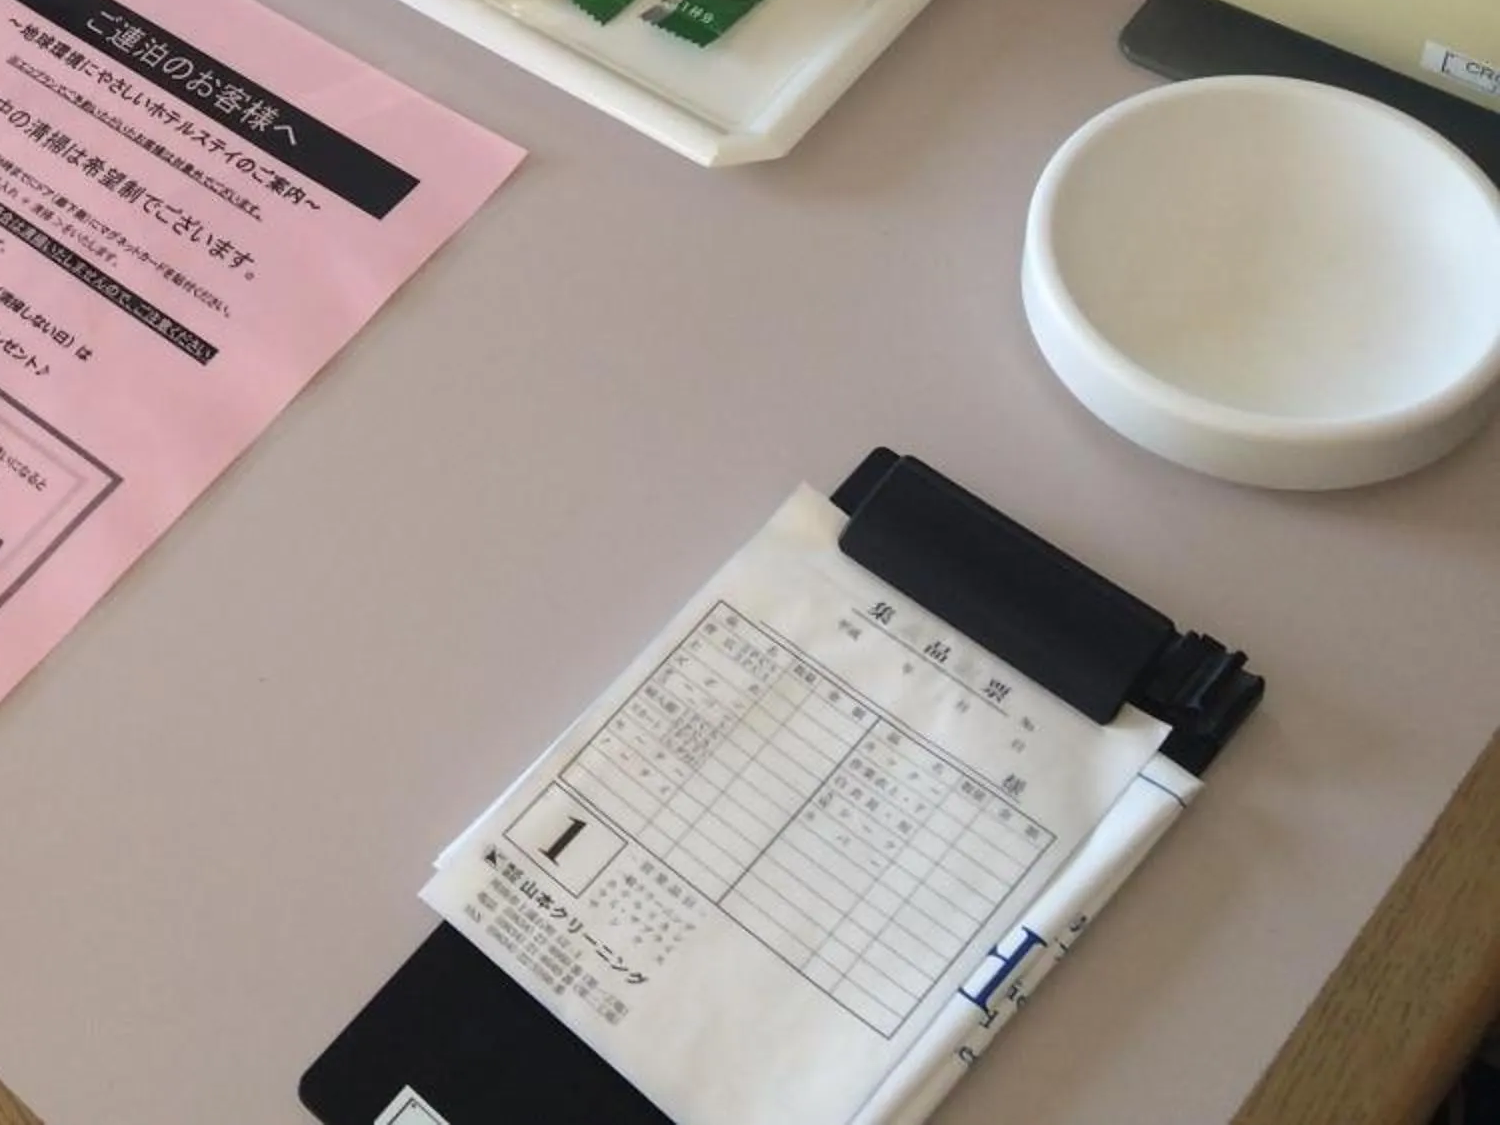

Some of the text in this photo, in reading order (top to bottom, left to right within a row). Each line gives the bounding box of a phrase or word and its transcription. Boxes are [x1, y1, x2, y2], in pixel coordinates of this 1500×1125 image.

[80, 5, 311, 151] ご連泊のお客様へ
[999, 771, 1029, 797] 様
[534, 813, 594, 867] 1
[516, 877, 649, 990] 山本クリーニング
